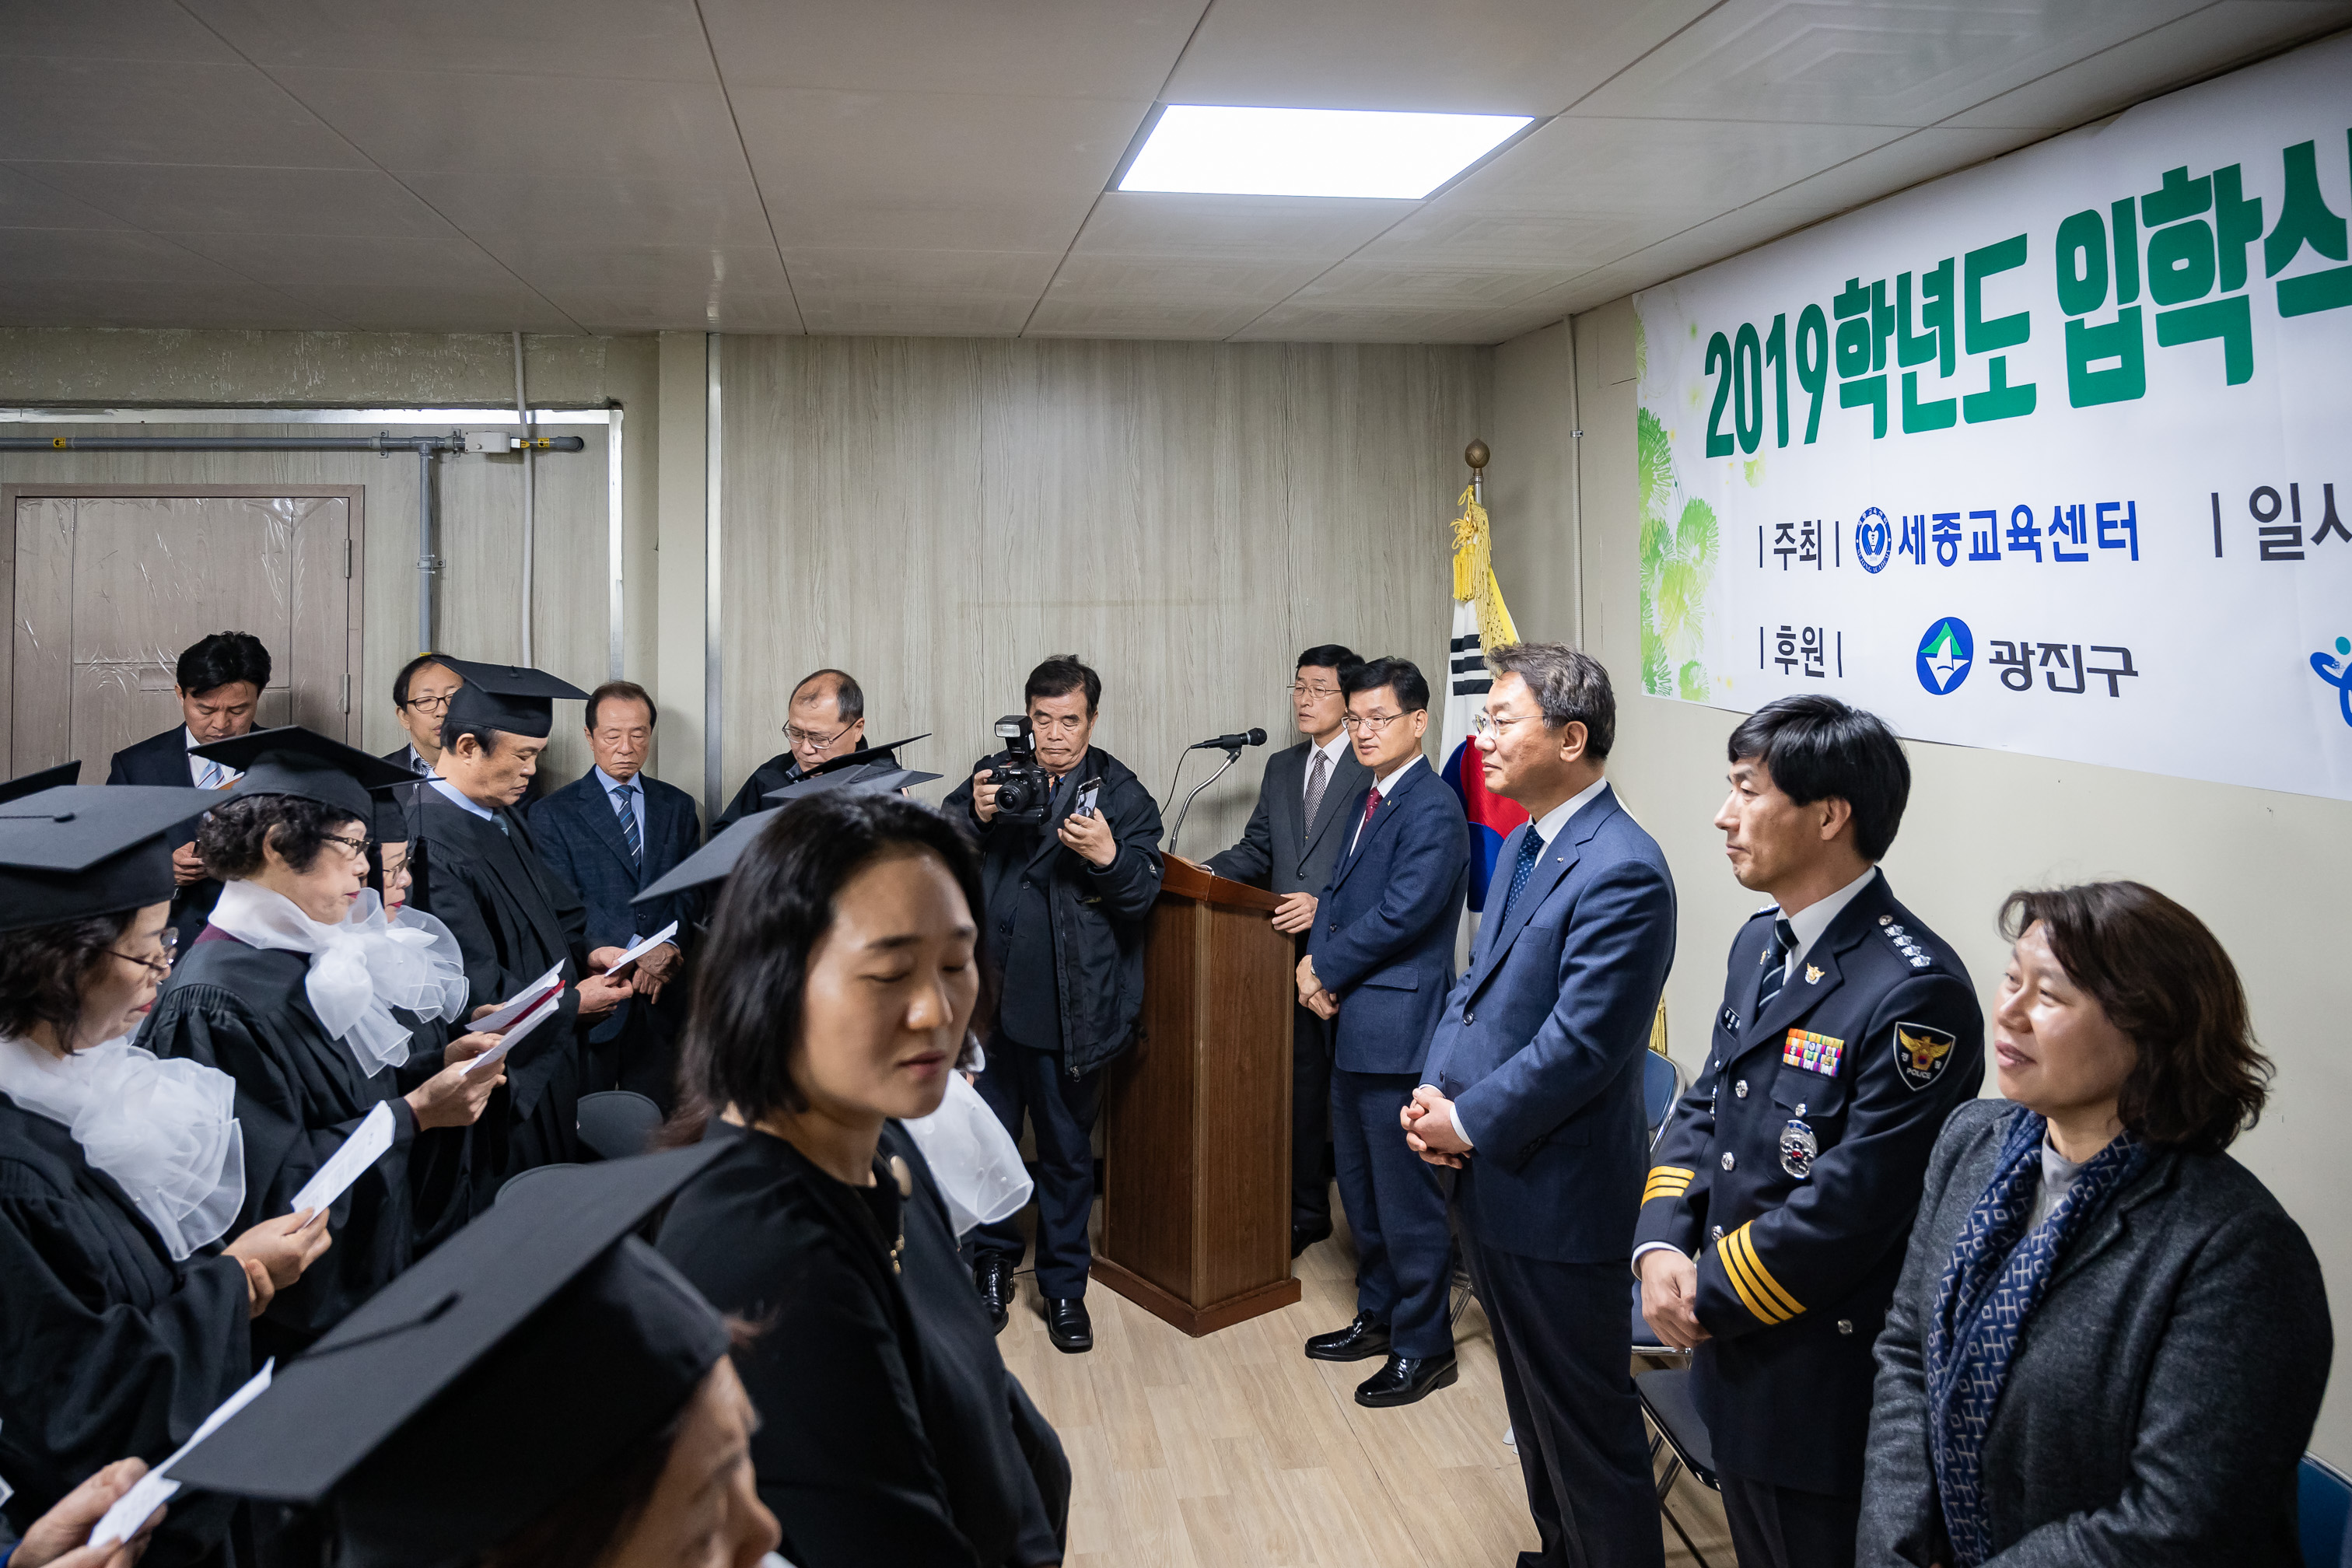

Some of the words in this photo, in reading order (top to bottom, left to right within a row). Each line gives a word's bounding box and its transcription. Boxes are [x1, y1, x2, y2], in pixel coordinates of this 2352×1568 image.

[1704, 233, 2037, 459] 2019학년도
[1899, 500, 2139, 567] 세종교육센터
[1989, 640, 2139, 698] 광진구
[1906, 1067, 1931, 1080] POLICE
